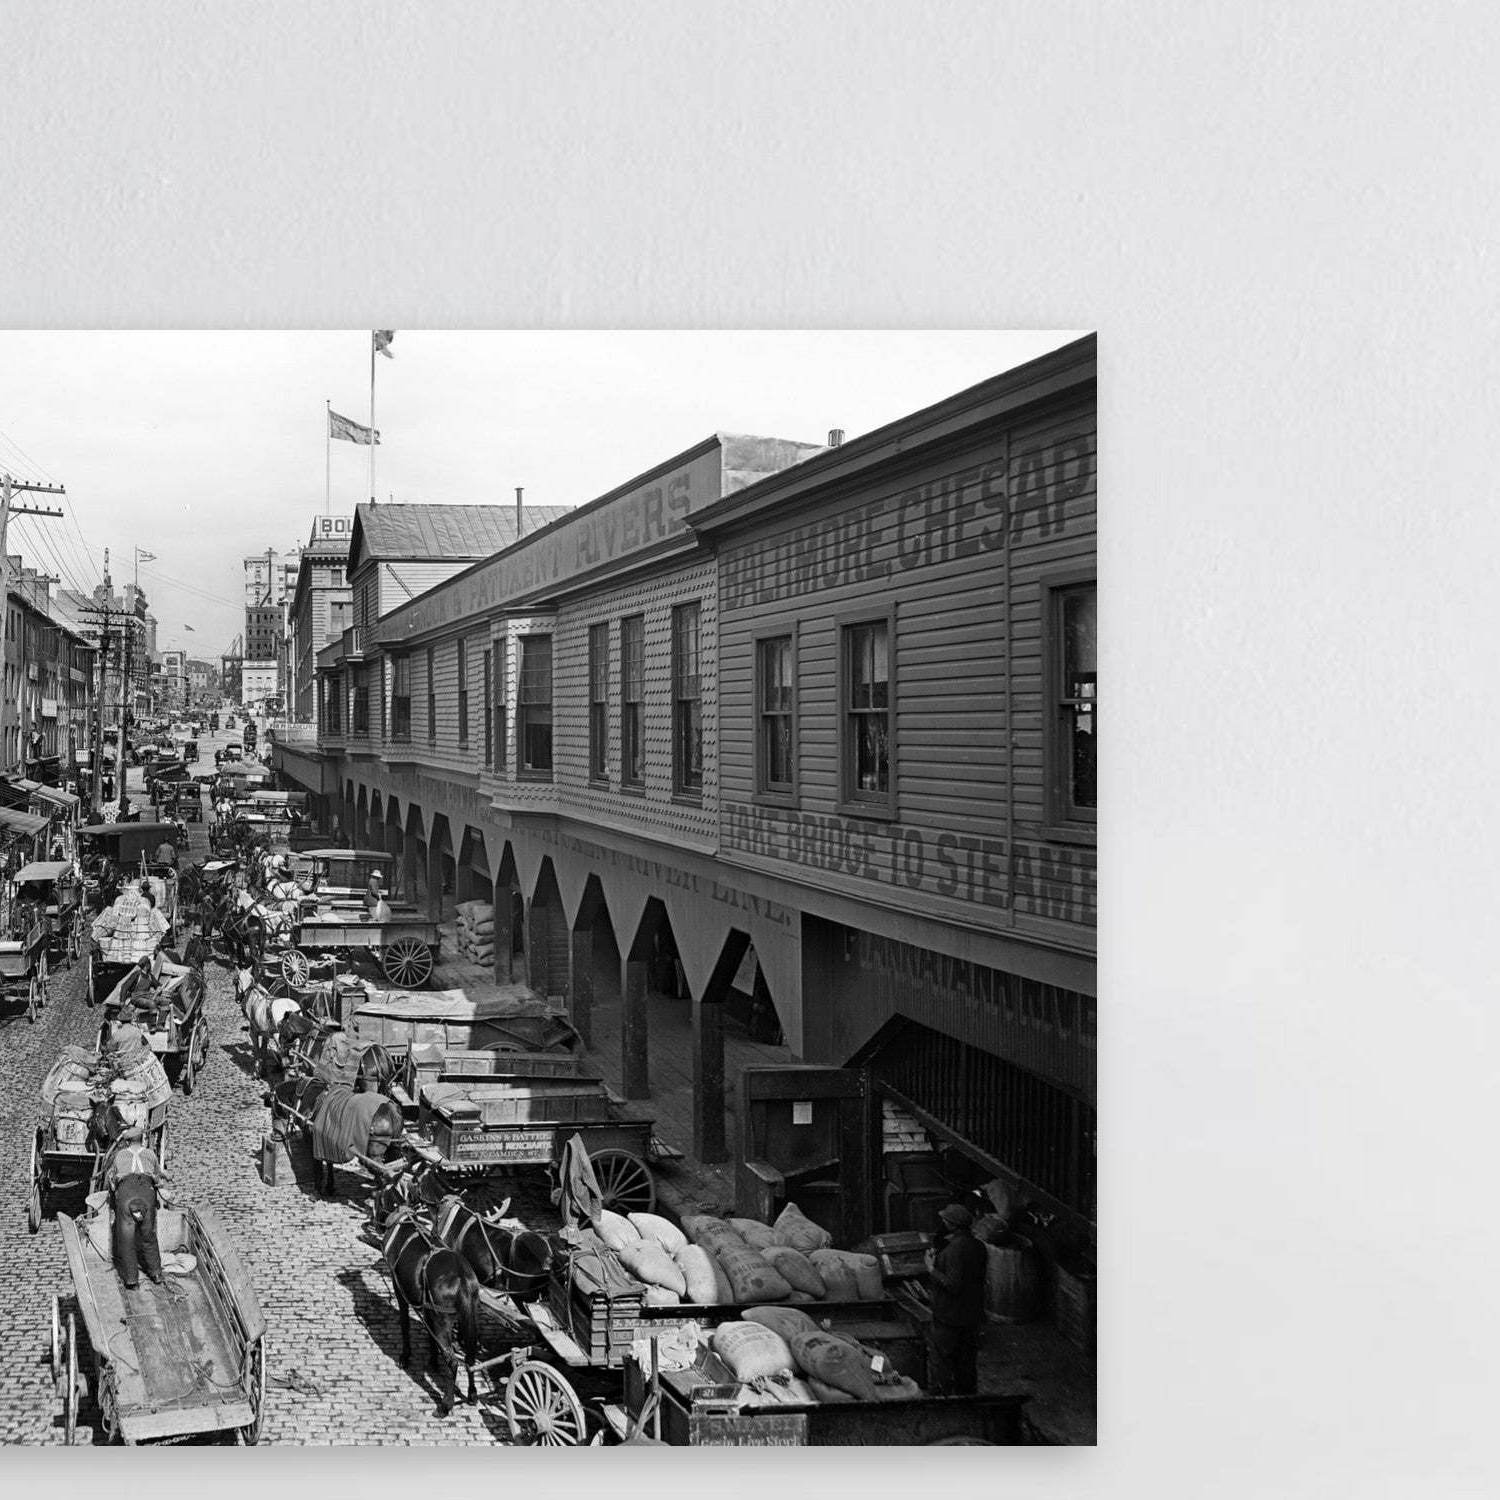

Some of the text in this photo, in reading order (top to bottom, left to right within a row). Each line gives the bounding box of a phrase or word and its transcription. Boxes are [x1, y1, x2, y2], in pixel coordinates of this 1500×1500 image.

[575, 467, 691, 571] RIVERS
[725, 802, 780, 860] TAKE
[787, 811, 880, 880] BRIDGE
[886, 826, 924, 889] TO
[460, 1133, 502, 1143] GASKINS
[503, 1132, 511, 1141] &
